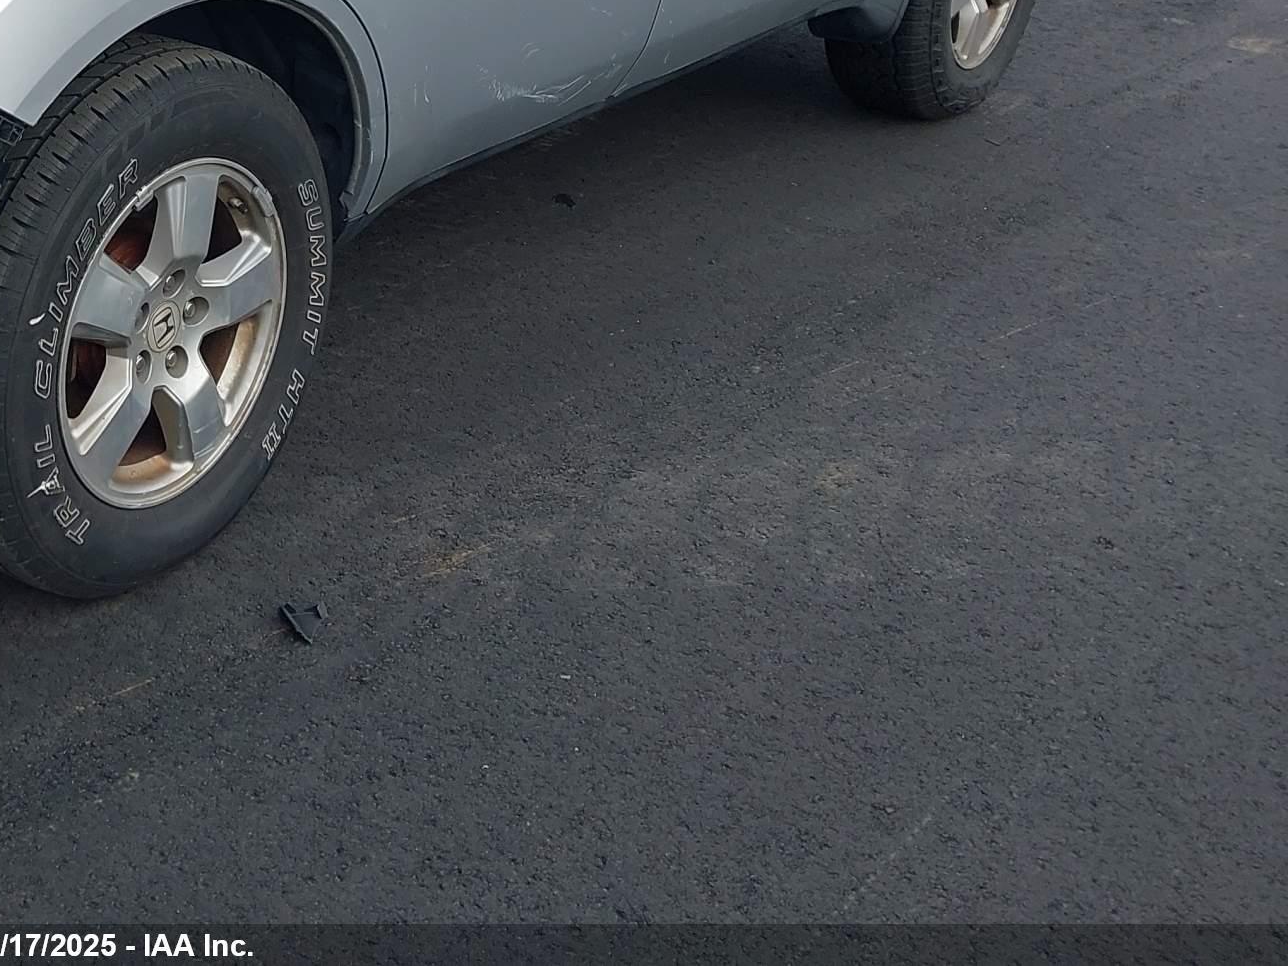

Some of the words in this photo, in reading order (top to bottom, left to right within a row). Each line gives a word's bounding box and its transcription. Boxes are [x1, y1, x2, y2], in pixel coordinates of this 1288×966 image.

[35, 158, 139, 399] CLIMBER
[298, 179, 327, 354] SUMMIT
[34, 423, 90, 545] TRAIL
